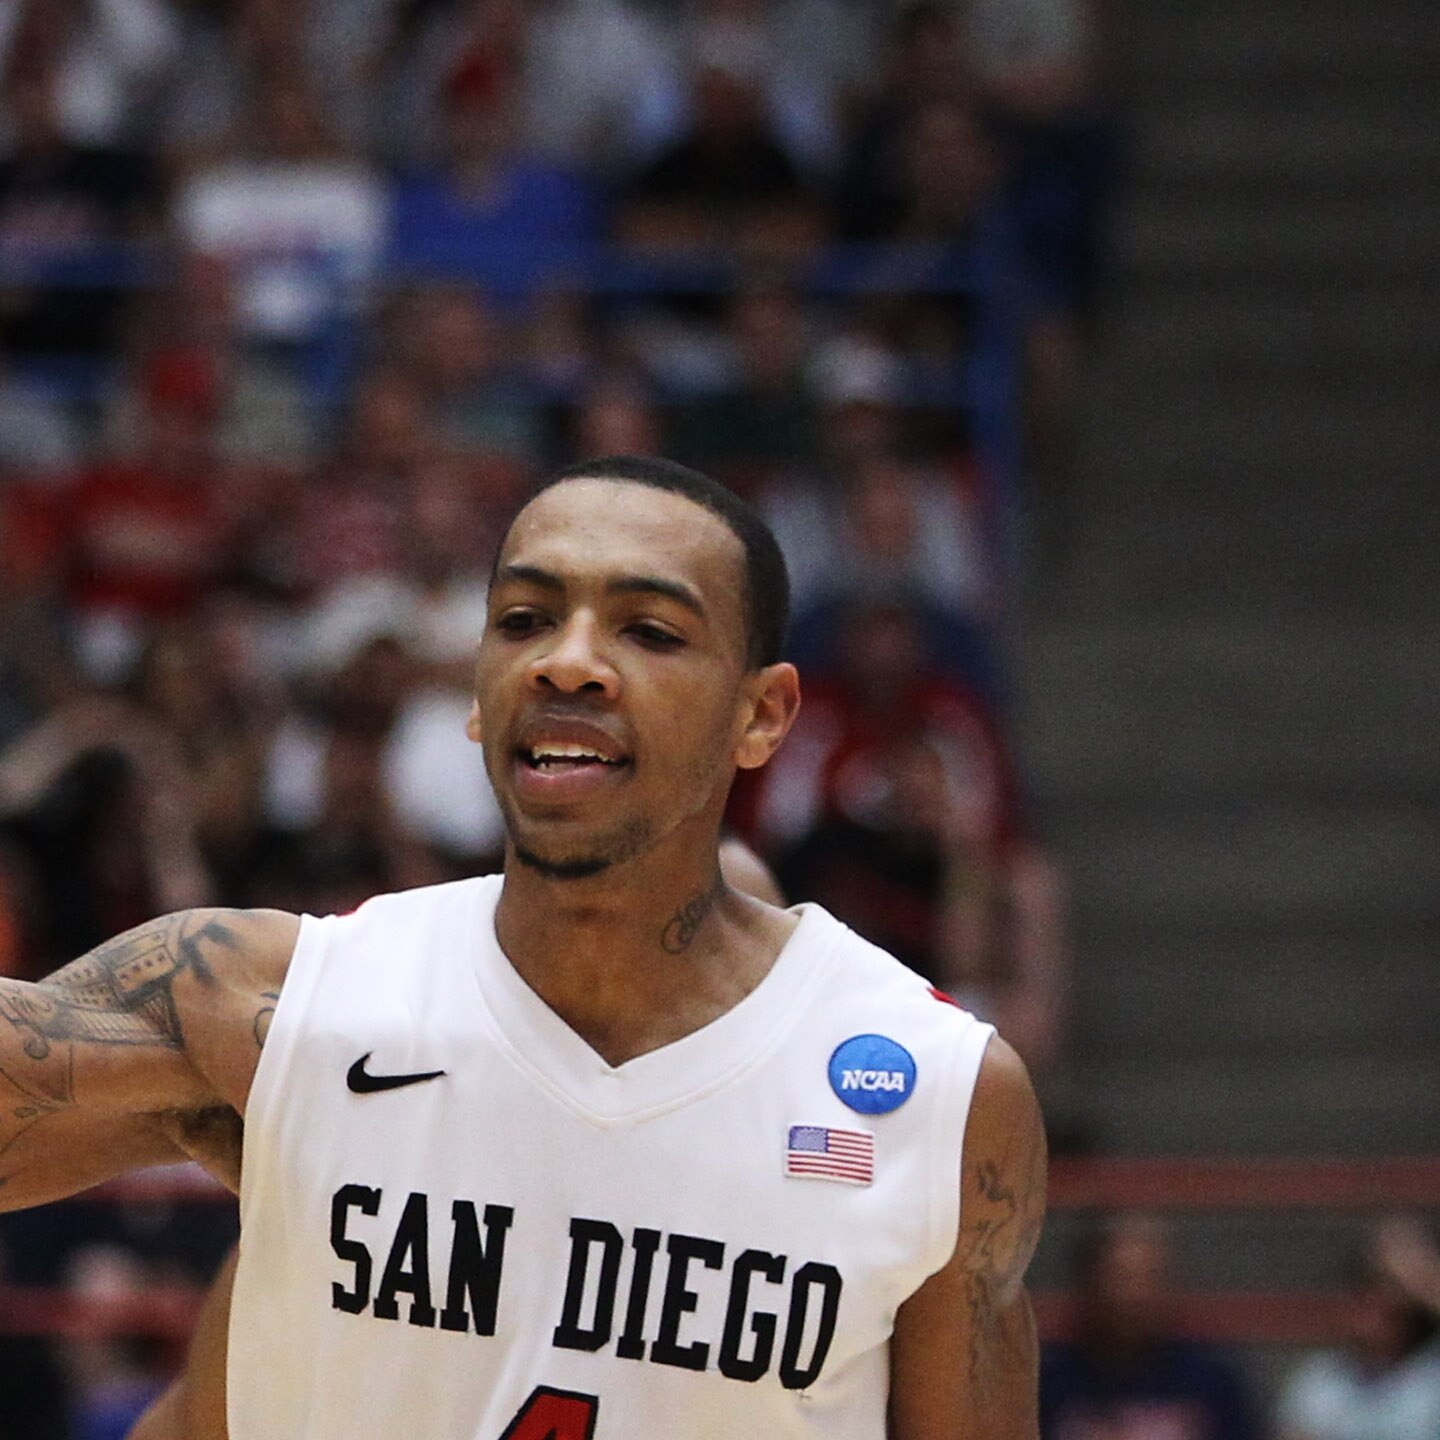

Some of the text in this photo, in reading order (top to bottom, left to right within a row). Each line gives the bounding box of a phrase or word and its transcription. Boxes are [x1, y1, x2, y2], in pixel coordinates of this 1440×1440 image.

[841, 1069, 905, 1094] NCAA
[329, 1183, 844, 1391] SAN DIEGO
